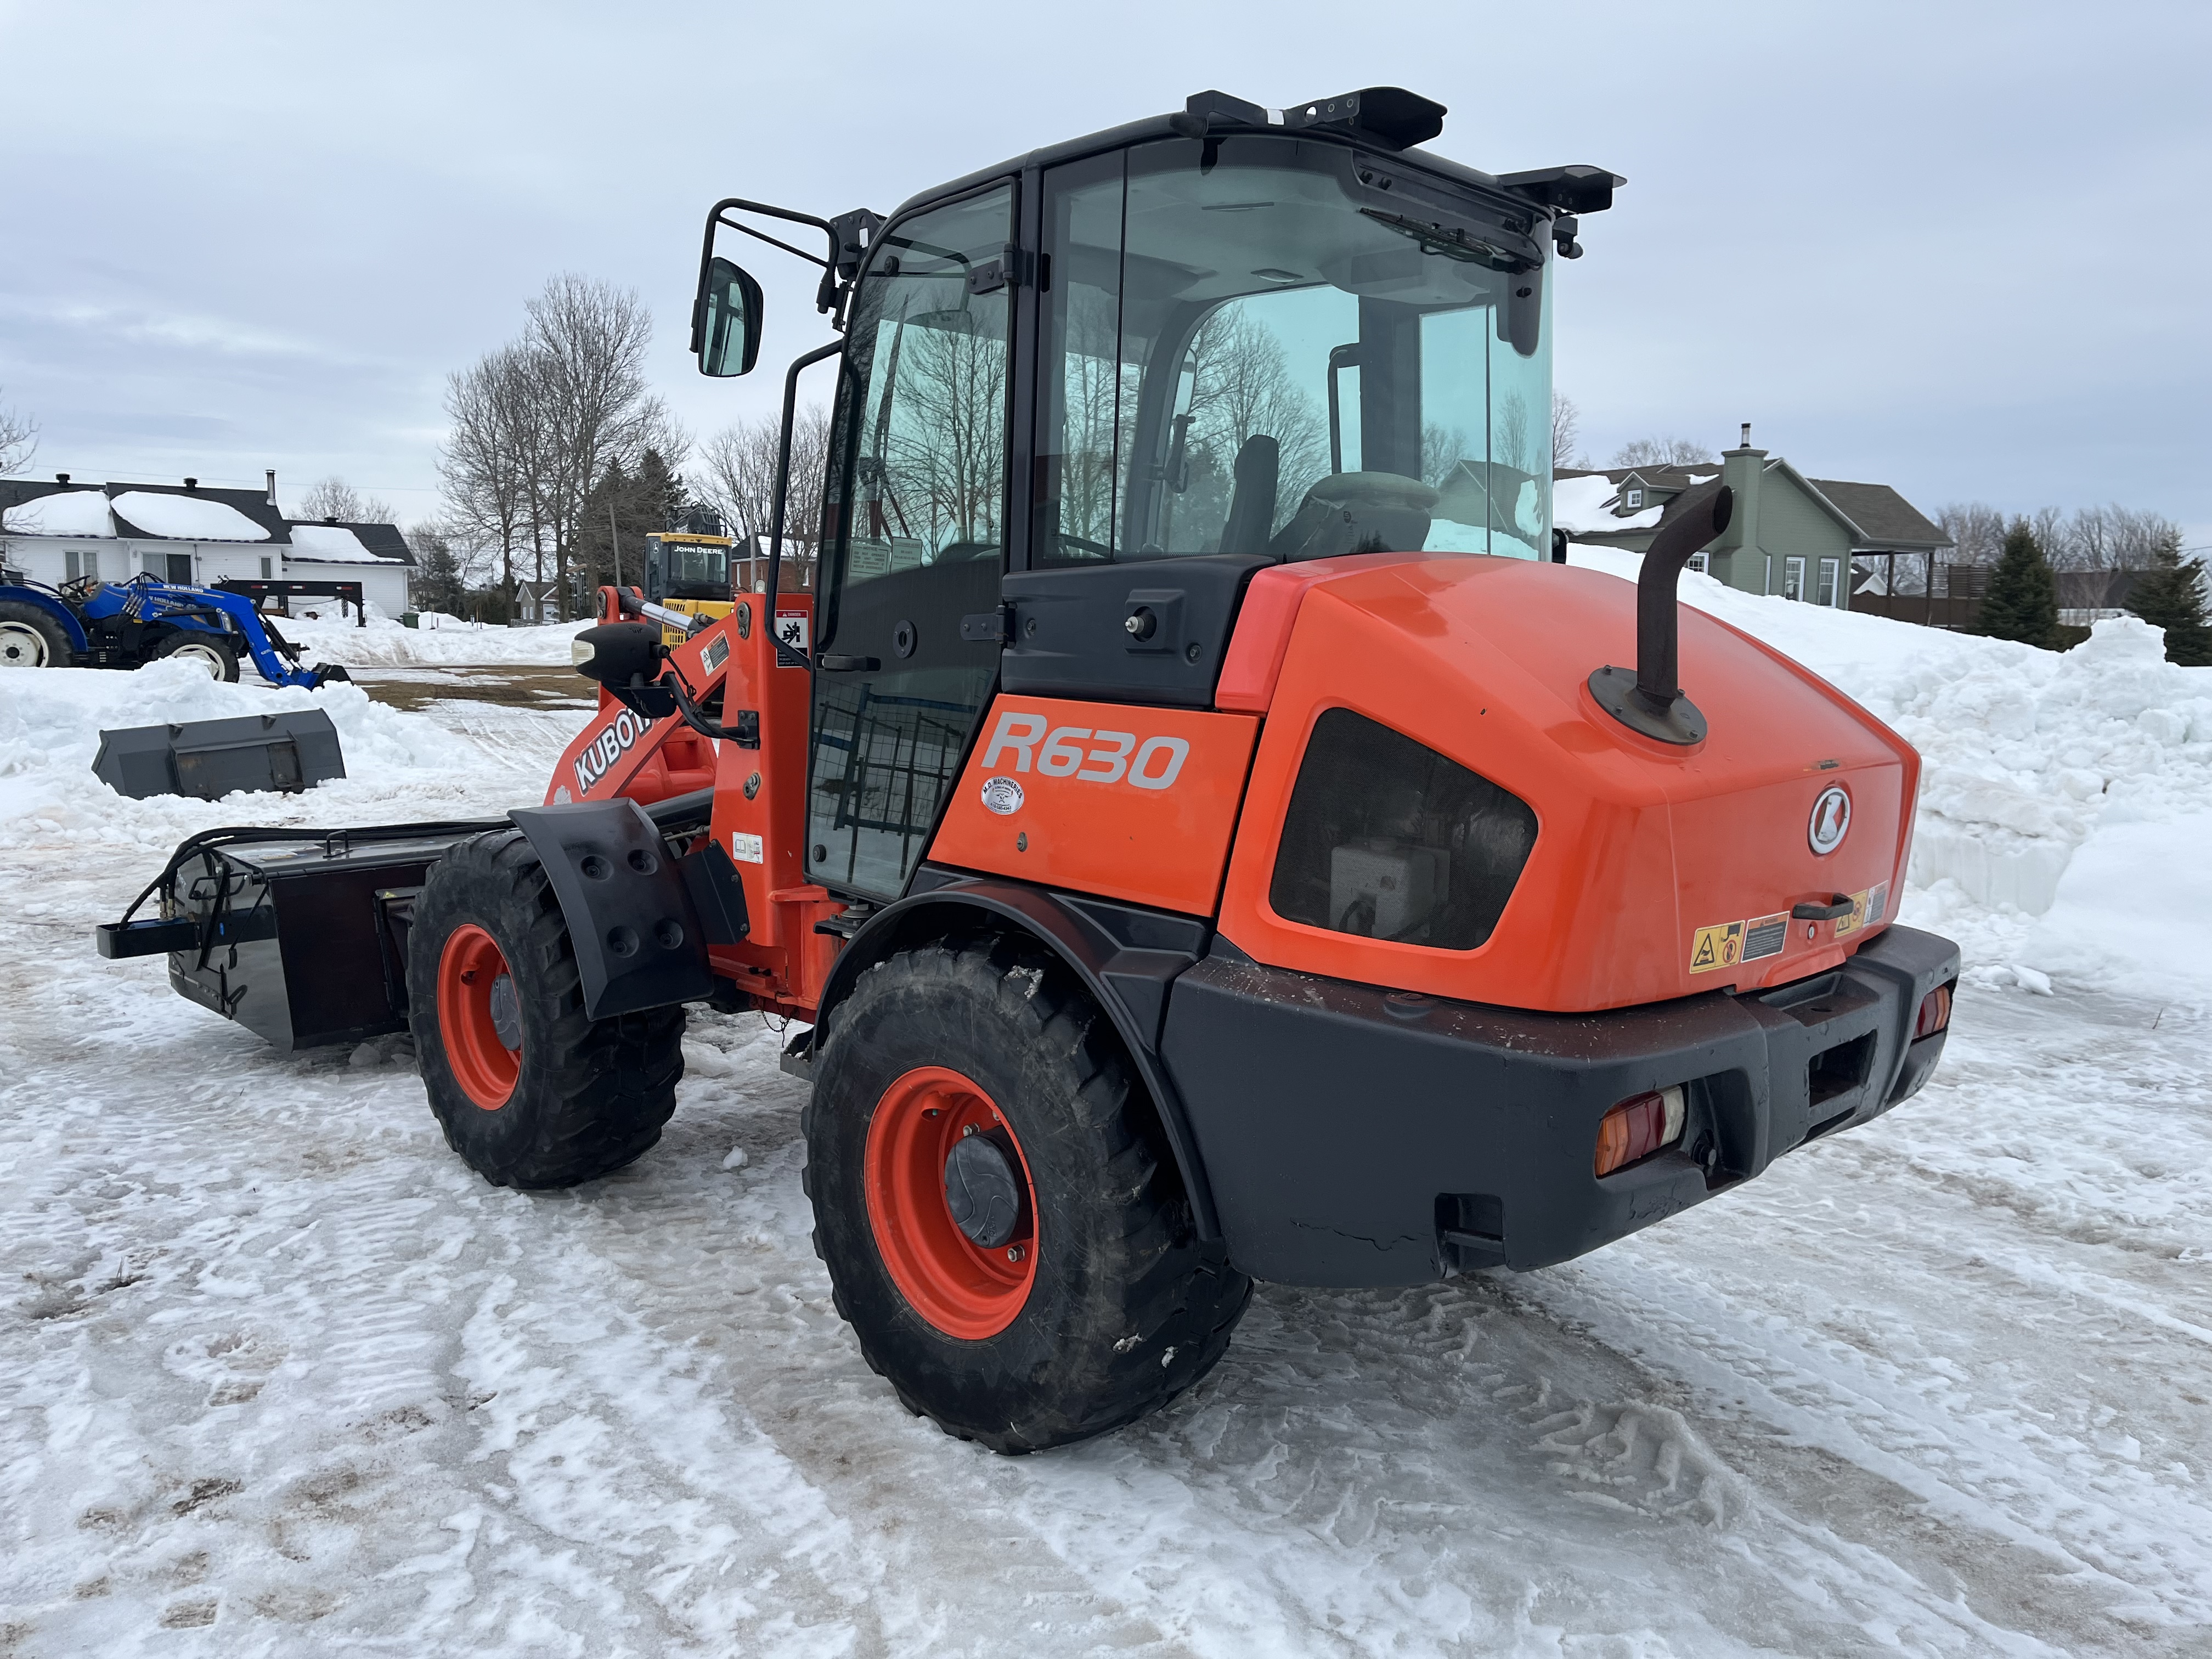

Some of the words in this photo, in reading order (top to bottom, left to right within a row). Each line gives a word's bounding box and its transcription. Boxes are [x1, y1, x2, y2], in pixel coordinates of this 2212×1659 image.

[697, 546, 723, 555] DEERE
[574, 707, 652, 792] KUBOT
[981, 712, 1190, 790] R630
[993, 778, 1023, 799] MACHINERIES
